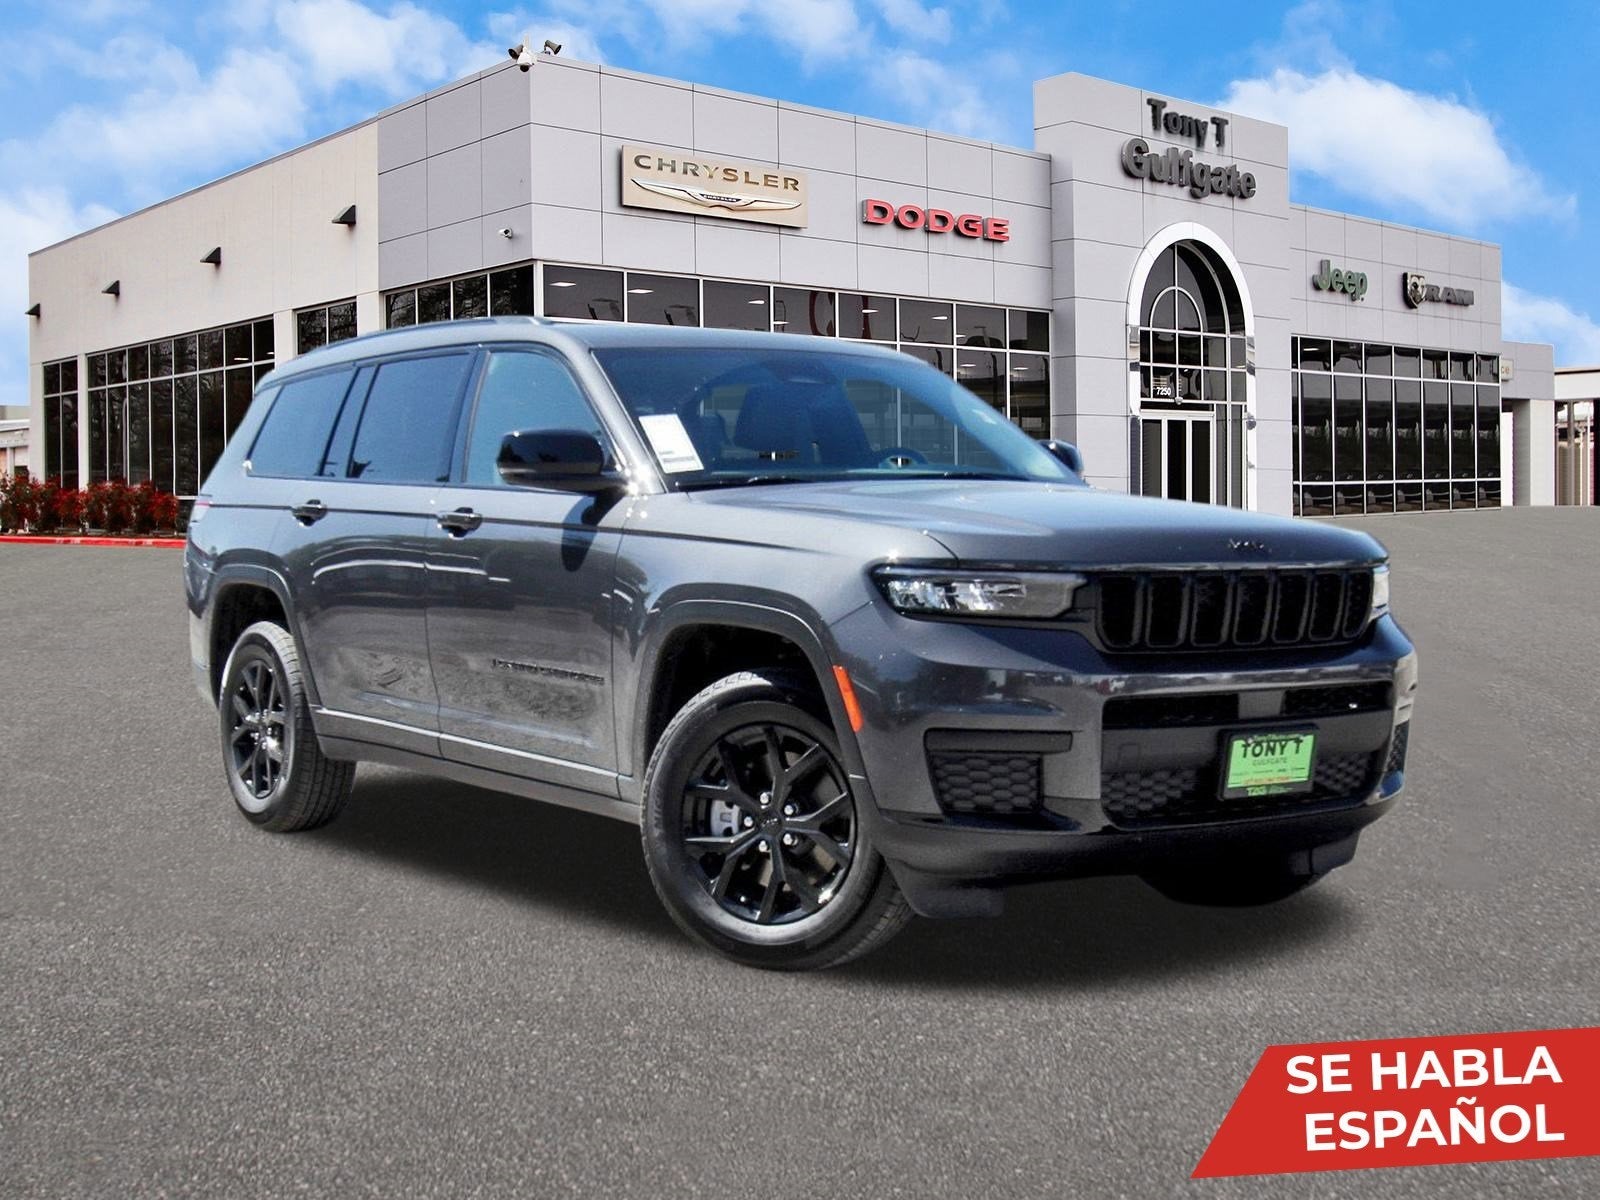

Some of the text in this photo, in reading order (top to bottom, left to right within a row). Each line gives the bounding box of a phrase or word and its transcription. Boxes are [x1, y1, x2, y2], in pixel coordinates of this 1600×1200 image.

[1146, 98, 1229, 148] Tony T
[633, 154, 800, 192] CHRYSLER
[1121, 138, 1257, 199] Gulfgate
[862, 198, 1010, 242] DODGE
[1312, 259, 1368, 302] Jeep
[1424, 284, 1475, 306] RAM
[1156, 387, 1172, 396] 7250
[1241, 737, 1304, 758] TONY T
